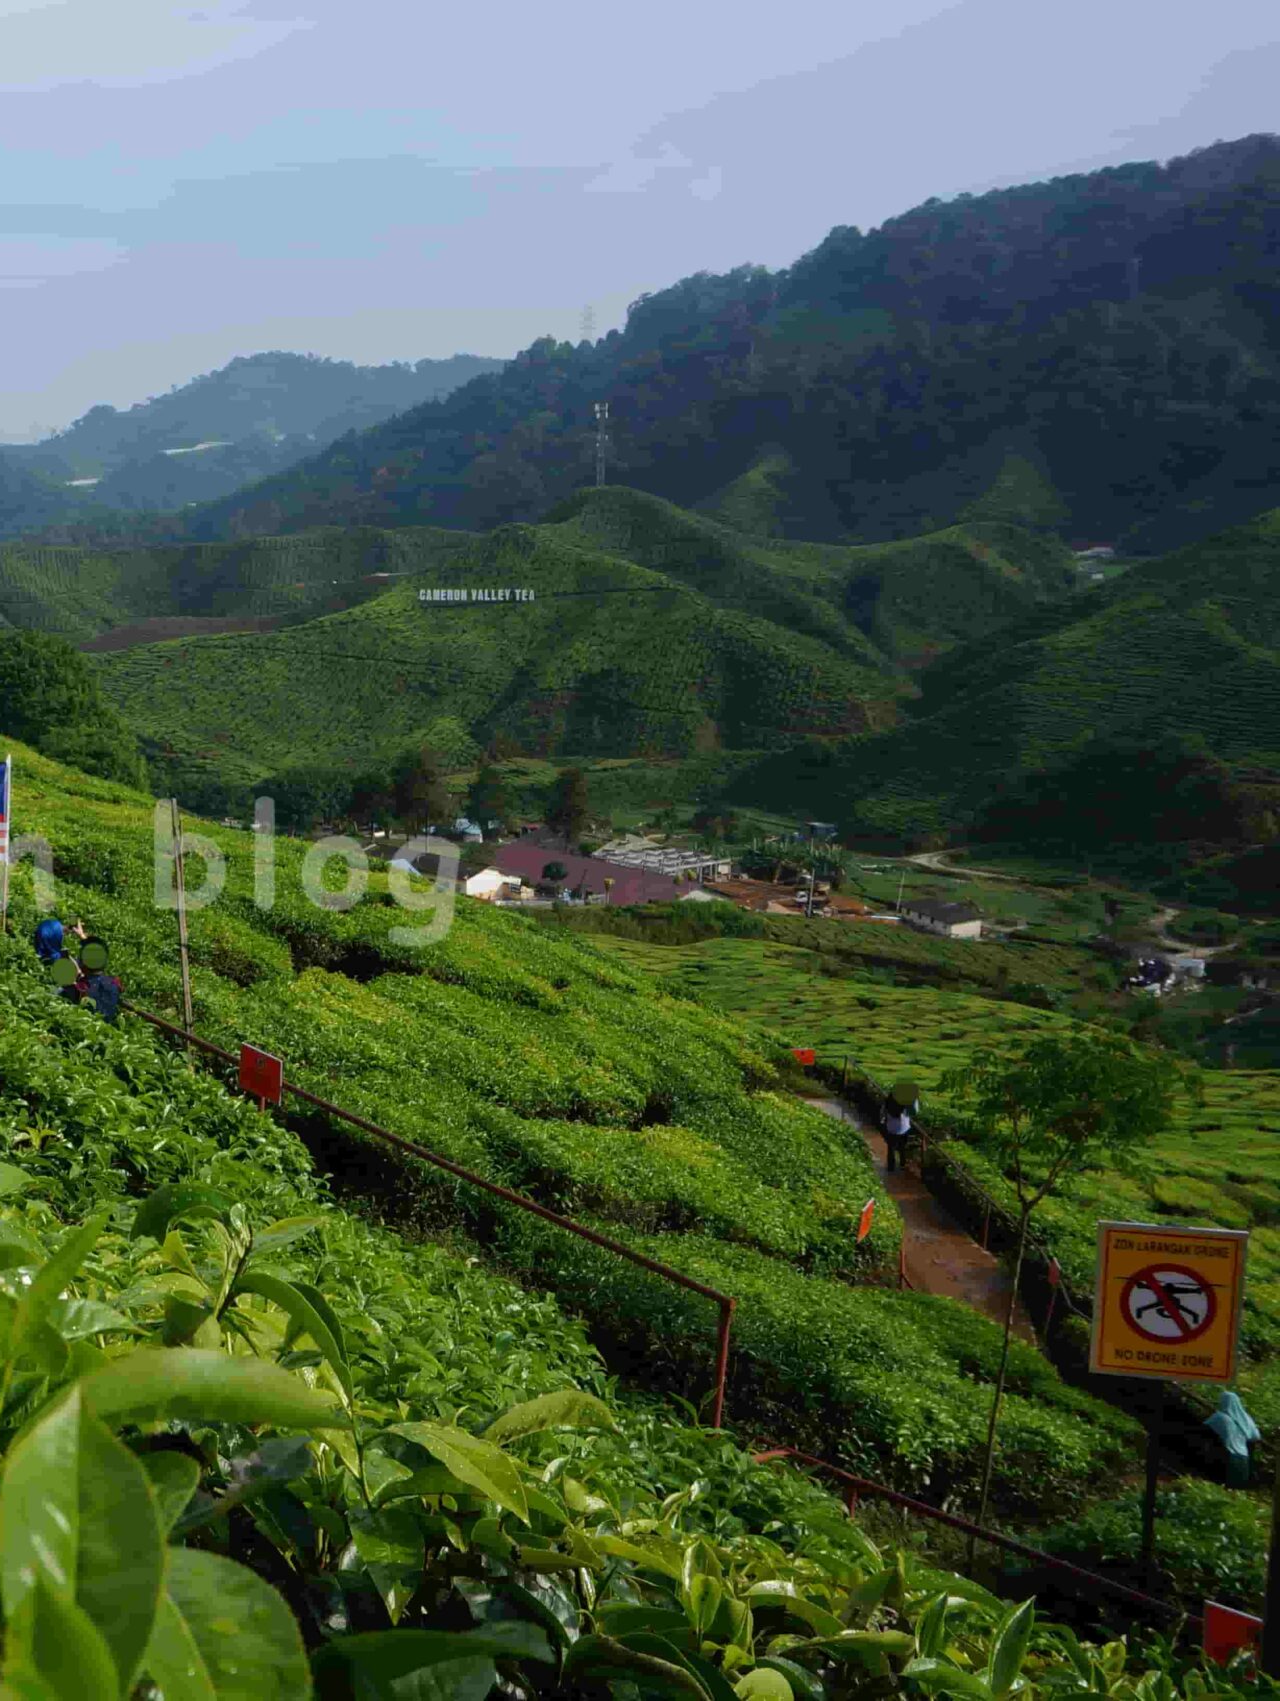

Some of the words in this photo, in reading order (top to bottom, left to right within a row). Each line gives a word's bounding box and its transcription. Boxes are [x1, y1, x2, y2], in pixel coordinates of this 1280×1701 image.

[419, 588, 468, 601] CAMERON
[471, 588, 511, 601] VALLEY
[514, 588, 536, 601] TEA
[1113, 1238, 1135, 1250] ZON
[1136, 1240, 1191, 1255] LARANGAN
[1114, 1348, 1133, 1361] NO
[1137, 1350, 1177, 1365] DRONE
[1181, 1353, 1214, 1367] ZONE
